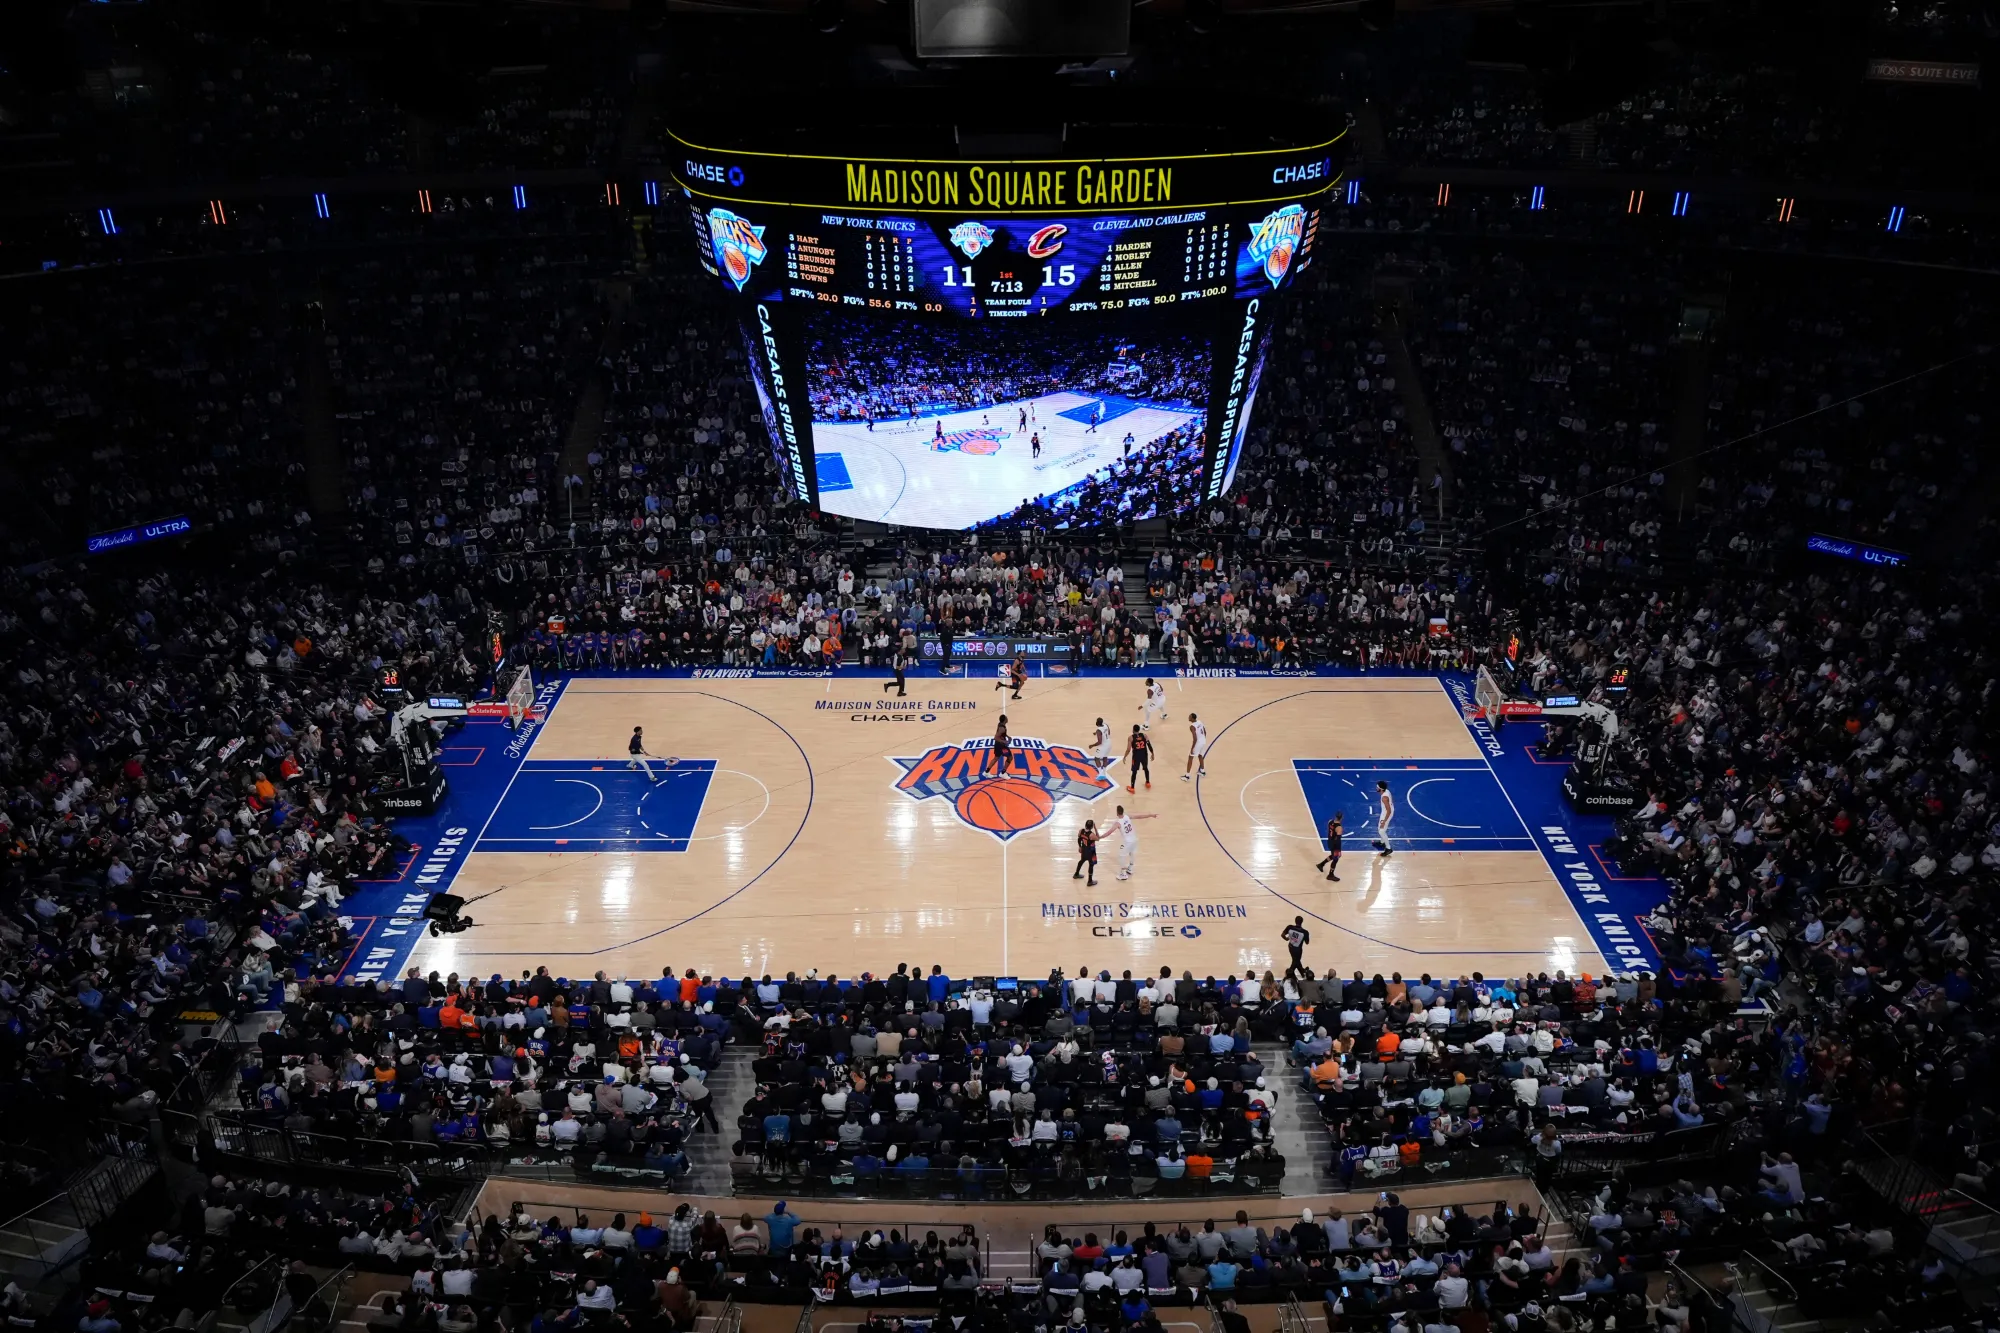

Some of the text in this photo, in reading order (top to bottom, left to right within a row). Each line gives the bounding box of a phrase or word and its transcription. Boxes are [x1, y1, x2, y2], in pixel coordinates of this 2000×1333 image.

[1910, 67, 1943, 78] SUITE
[687, 161, 725, 182] CHASE
[1273, 162, 1322, 183] CHASE
[847, 164, 1171, 208] MADISON SQUARE GARDEN
[822, 216, 915, 231] NEW YORK KNICKS
[1093, 212, 1206, 230] CLEVELAND CAVALIERS
[797, 235, 818, 244] HART
[954, 227, 991, 240] KNICKS
[798, 245, 835, 257] ANUNOBY
[1116, 242, 1151, 251] HARDEN
[799, 253, 835, 266] BRUNSON
[1115, 252, 1151, 261] MOBLEY
[799, 264, 834, 274] BRIDGES
[1114, 262, 1142, 270] ALLEN
[800, 273, 827, 283] TOWNS
[944, 266, 975, 286] 11
[1042, 265, 1075, 286] 15
[1114, 272, 1139, 280] WADE
[991, 281, 1023, 292] 7:13
[1114, 280, 1157, 290] MITCHELL
[790, 288, 814, 299] 3PT%
[817, 293, 838, 302] 20.0
[844, 296, 864, 305] FG%
[869, 299, 891, 308] 55.6
[896, 301, 917, 310] FT%
[1070, 286, 1226, 311] 3PT% 75.0 FG% 50.0 FT% 100.0
[757, 304, 810, 504] CAESARS SPORTSBOOK
[1207, 298, 1260, 500] CAESARS SPORTSBOOK
[89, 521, 190, 550] Michelob ULTRA
[1808, 538, 1905, 566] Michelob ULTR
[951, 642, 1046, 654] NSIDE UP NEXT
[702, 669, 754, 678] PLAYOFFS
[1187, 668, 1236, 678] PLAYOFFS
[815, 700, 976, 710] MADISON SQUARE GARDEN
[504, 722, 536, 758] Michelob
[964, 738, 994, 748] NEW
[1473, 722, 1504, 757] ULTRA
[384, 798, 422, 807] inbase
[1586, 796, 1634, 804] coinbase
[1541, 826, 1578, 854] NEW
[1564, 862, 1610, 904] YORK
[356, 828, 468, 982] NEW YORK KNICKS
[1042, 902, 1247, 918] MADISON SARE GARDEN
[1092, 926, 1175, 937] CHSE
